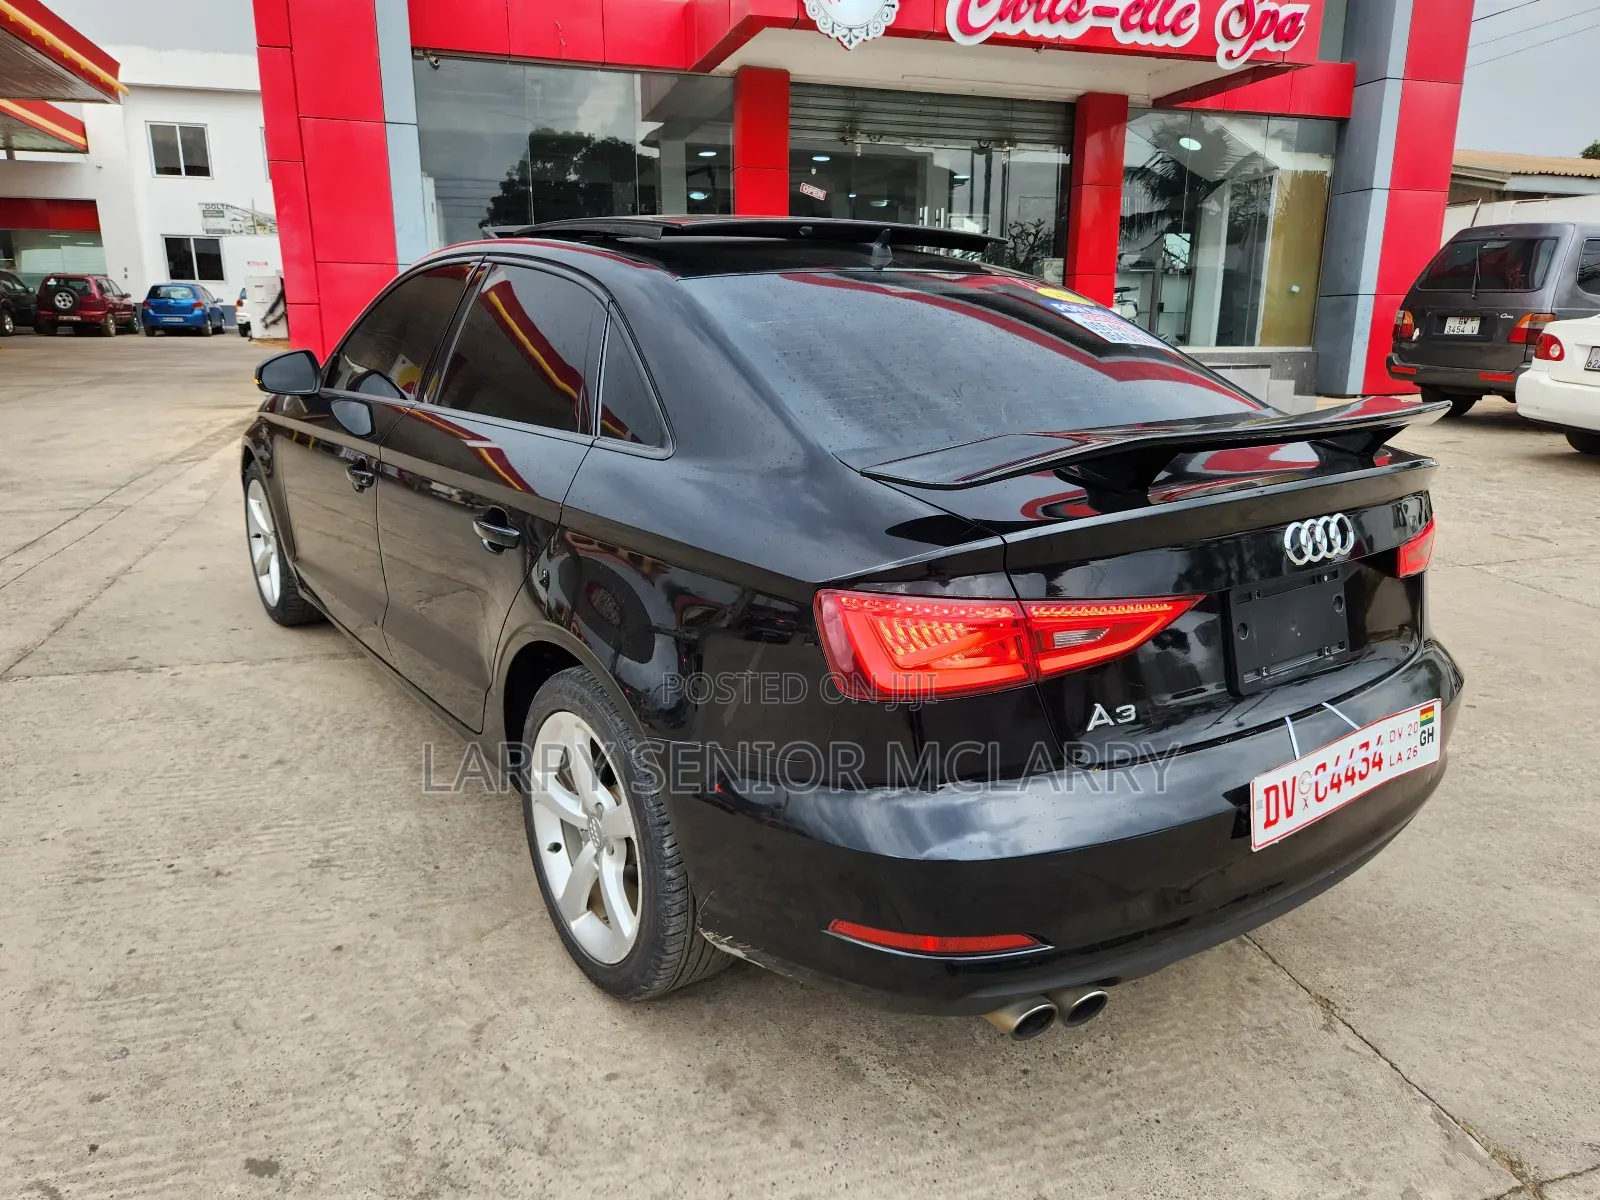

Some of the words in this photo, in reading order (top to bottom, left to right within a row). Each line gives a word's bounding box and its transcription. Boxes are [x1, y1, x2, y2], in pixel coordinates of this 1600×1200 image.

[1221, 0, 1305, 61] Spa
[802, 184, 826, 199] OPEN
[1446, 326, 1466, 334] 3454
[1087, 702, 1137, 732] A3
[1389, 727, 1403, 743] DV
[1407, 721, 1419, 737] 20
[1419, 726, 1435, 747] GH
[1389, 751, 1403, 767] LA
[1263, 775, 1297, 830] DV
